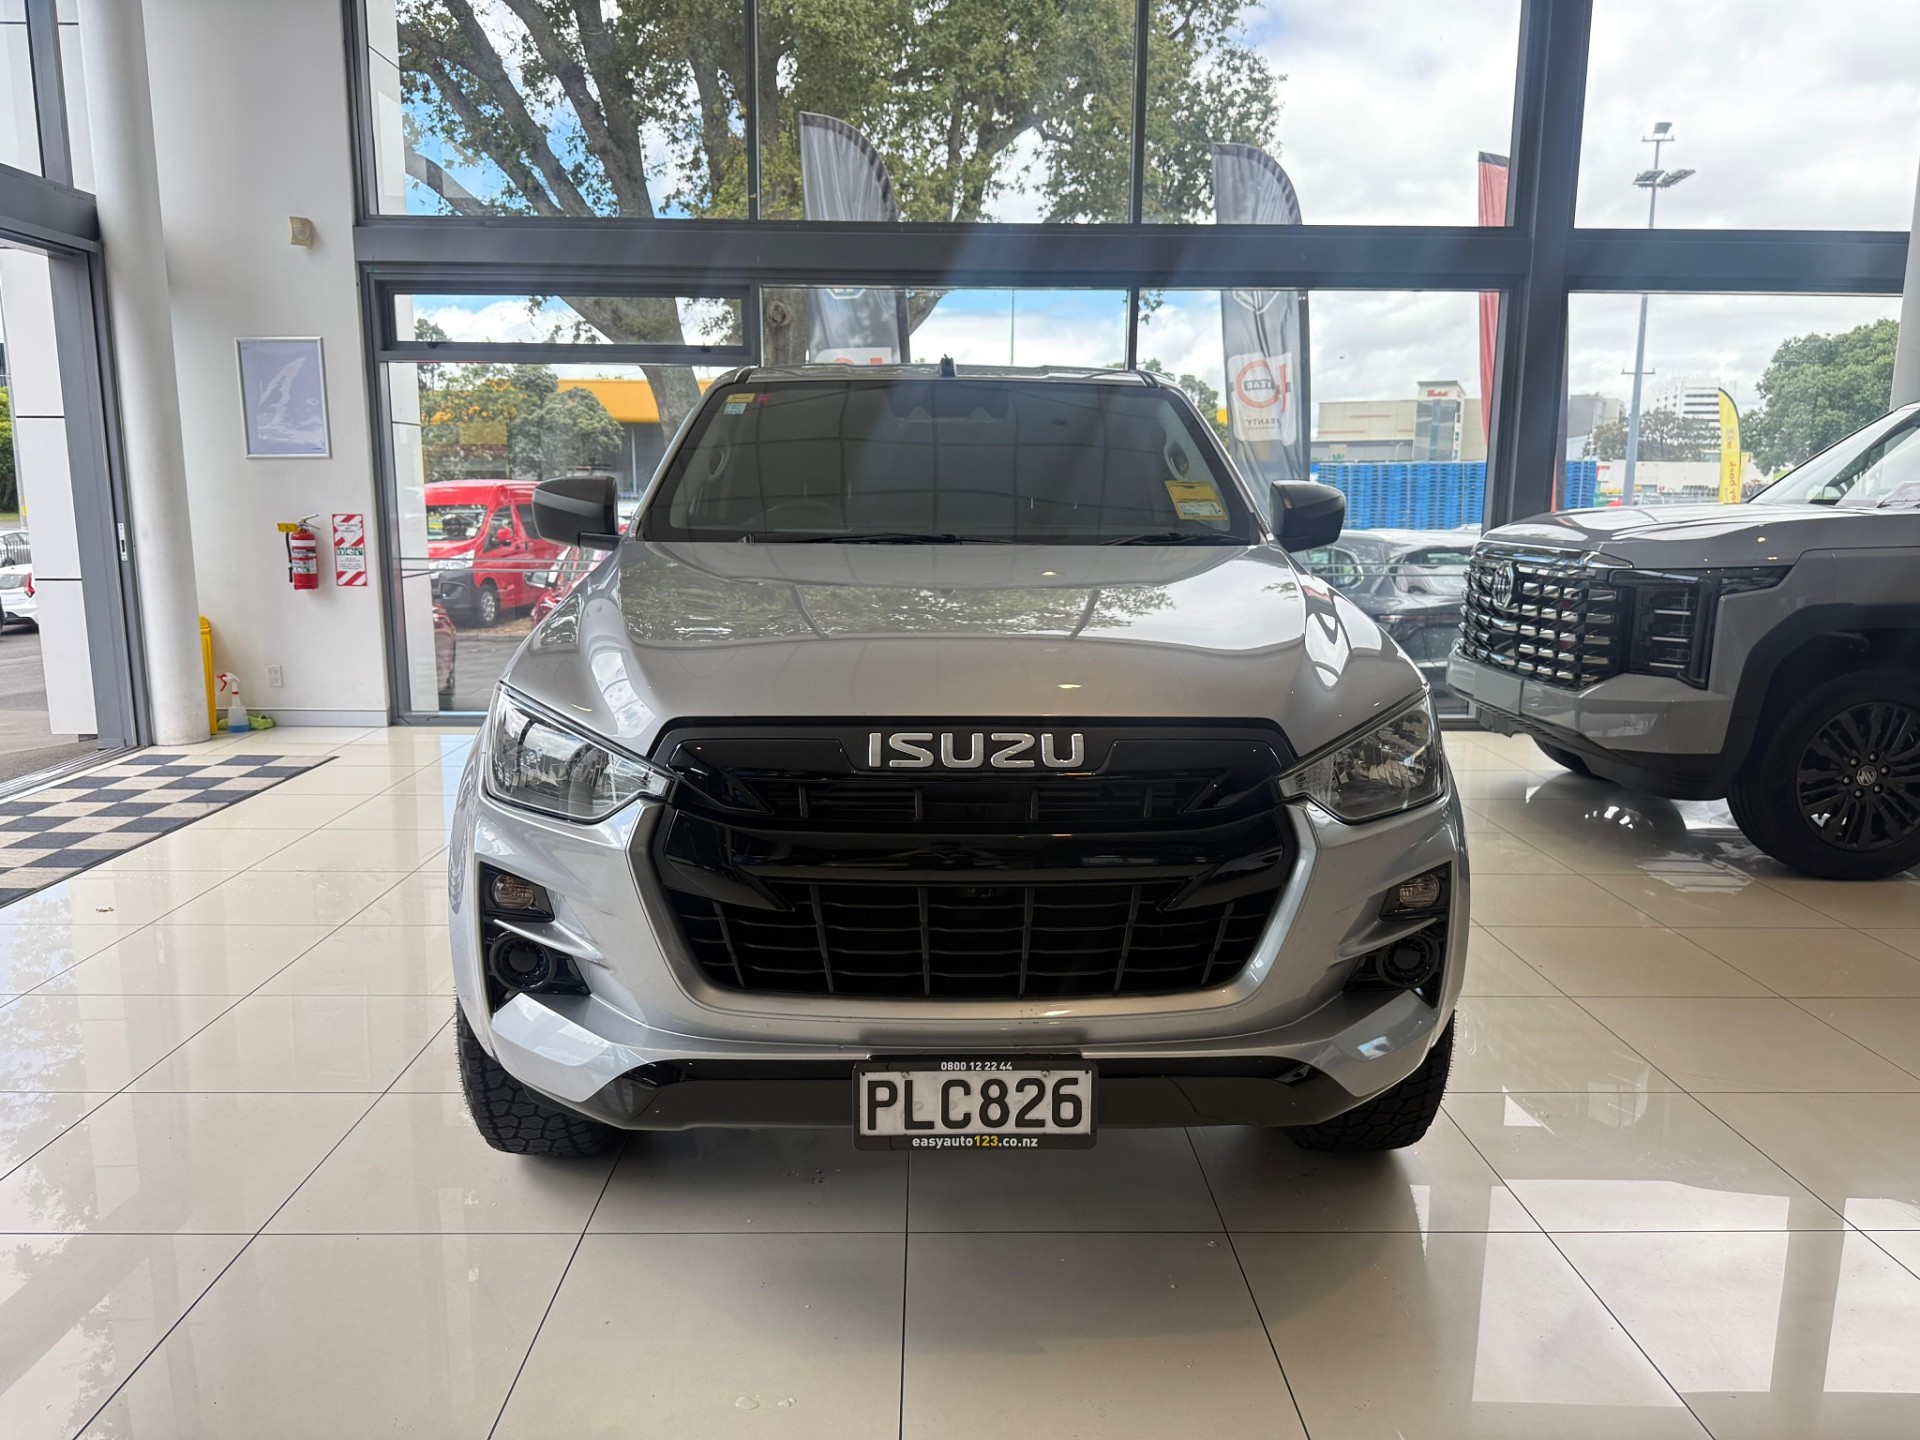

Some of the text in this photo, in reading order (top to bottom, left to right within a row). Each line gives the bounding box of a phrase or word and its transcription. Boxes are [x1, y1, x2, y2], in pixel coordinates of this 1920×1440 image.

[868, 732, 1085, 769] ISUZU
[940, 1061, 1013, 1071] 0800 12 22 44
[867, 1078, 1083, 1131] PLC826
[912, 1135, 1038, 1149] easyauto123.co.nz
